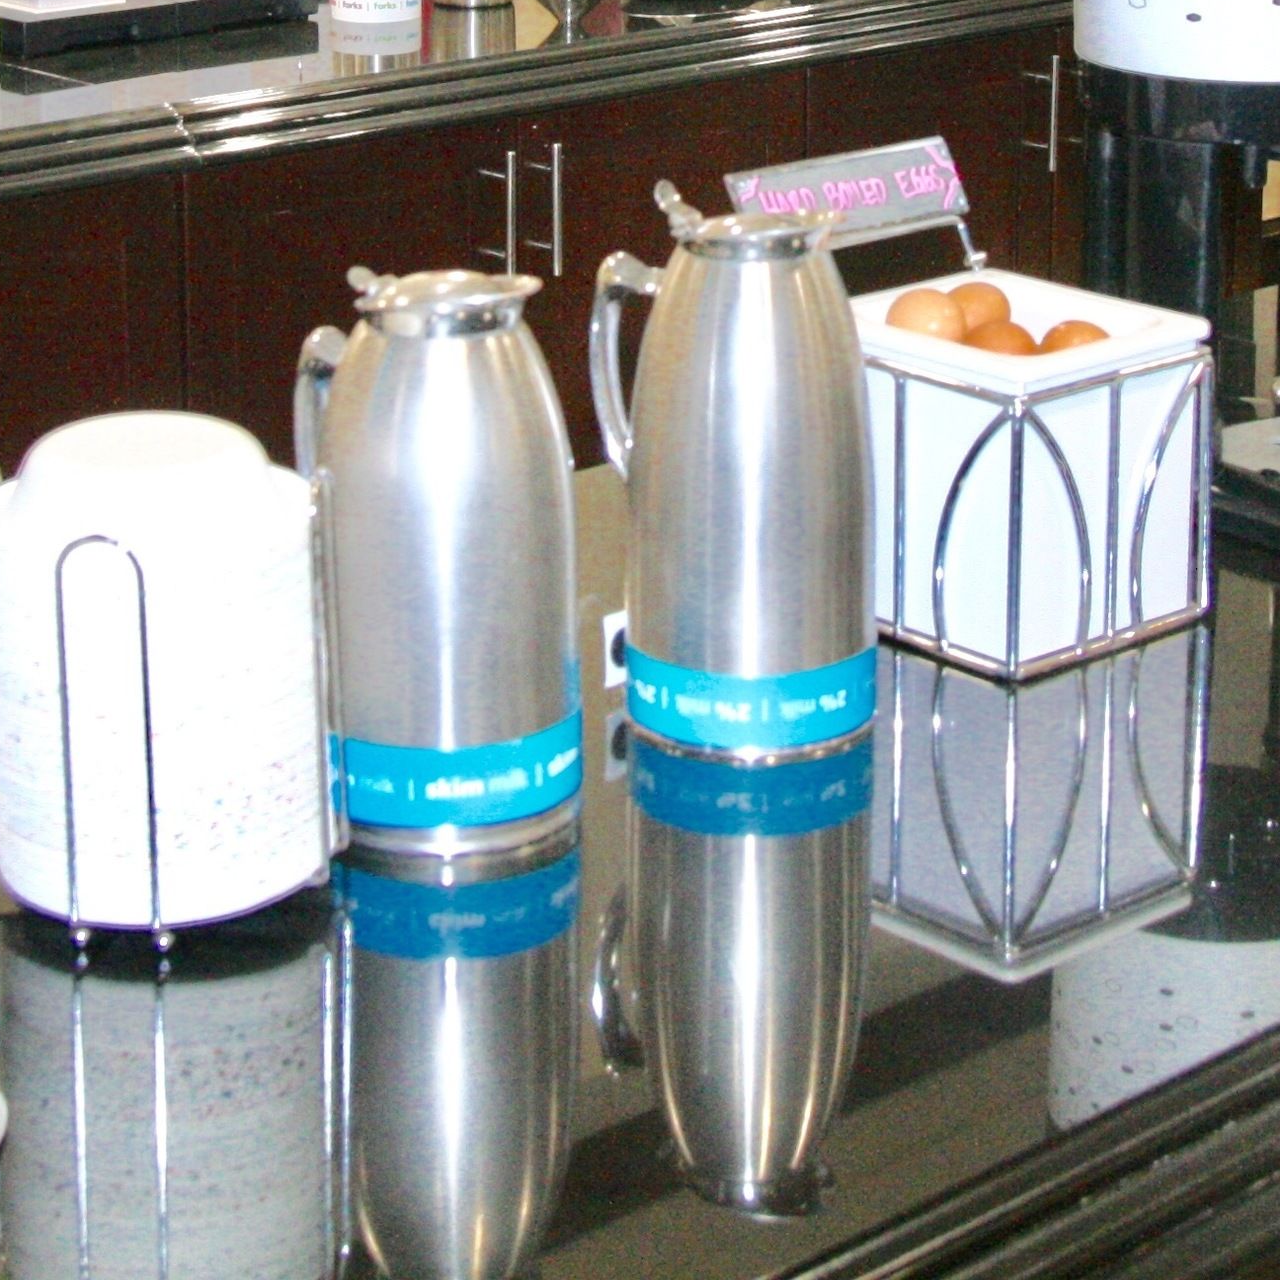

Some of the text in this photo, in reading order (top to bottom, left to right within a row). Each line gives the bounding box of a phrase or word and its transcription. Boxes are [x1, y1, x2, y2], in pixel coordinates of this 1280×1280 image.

[342, 0, 362, 10] forks
[757, 164, 946, 215] HARD BOILED EGGS
